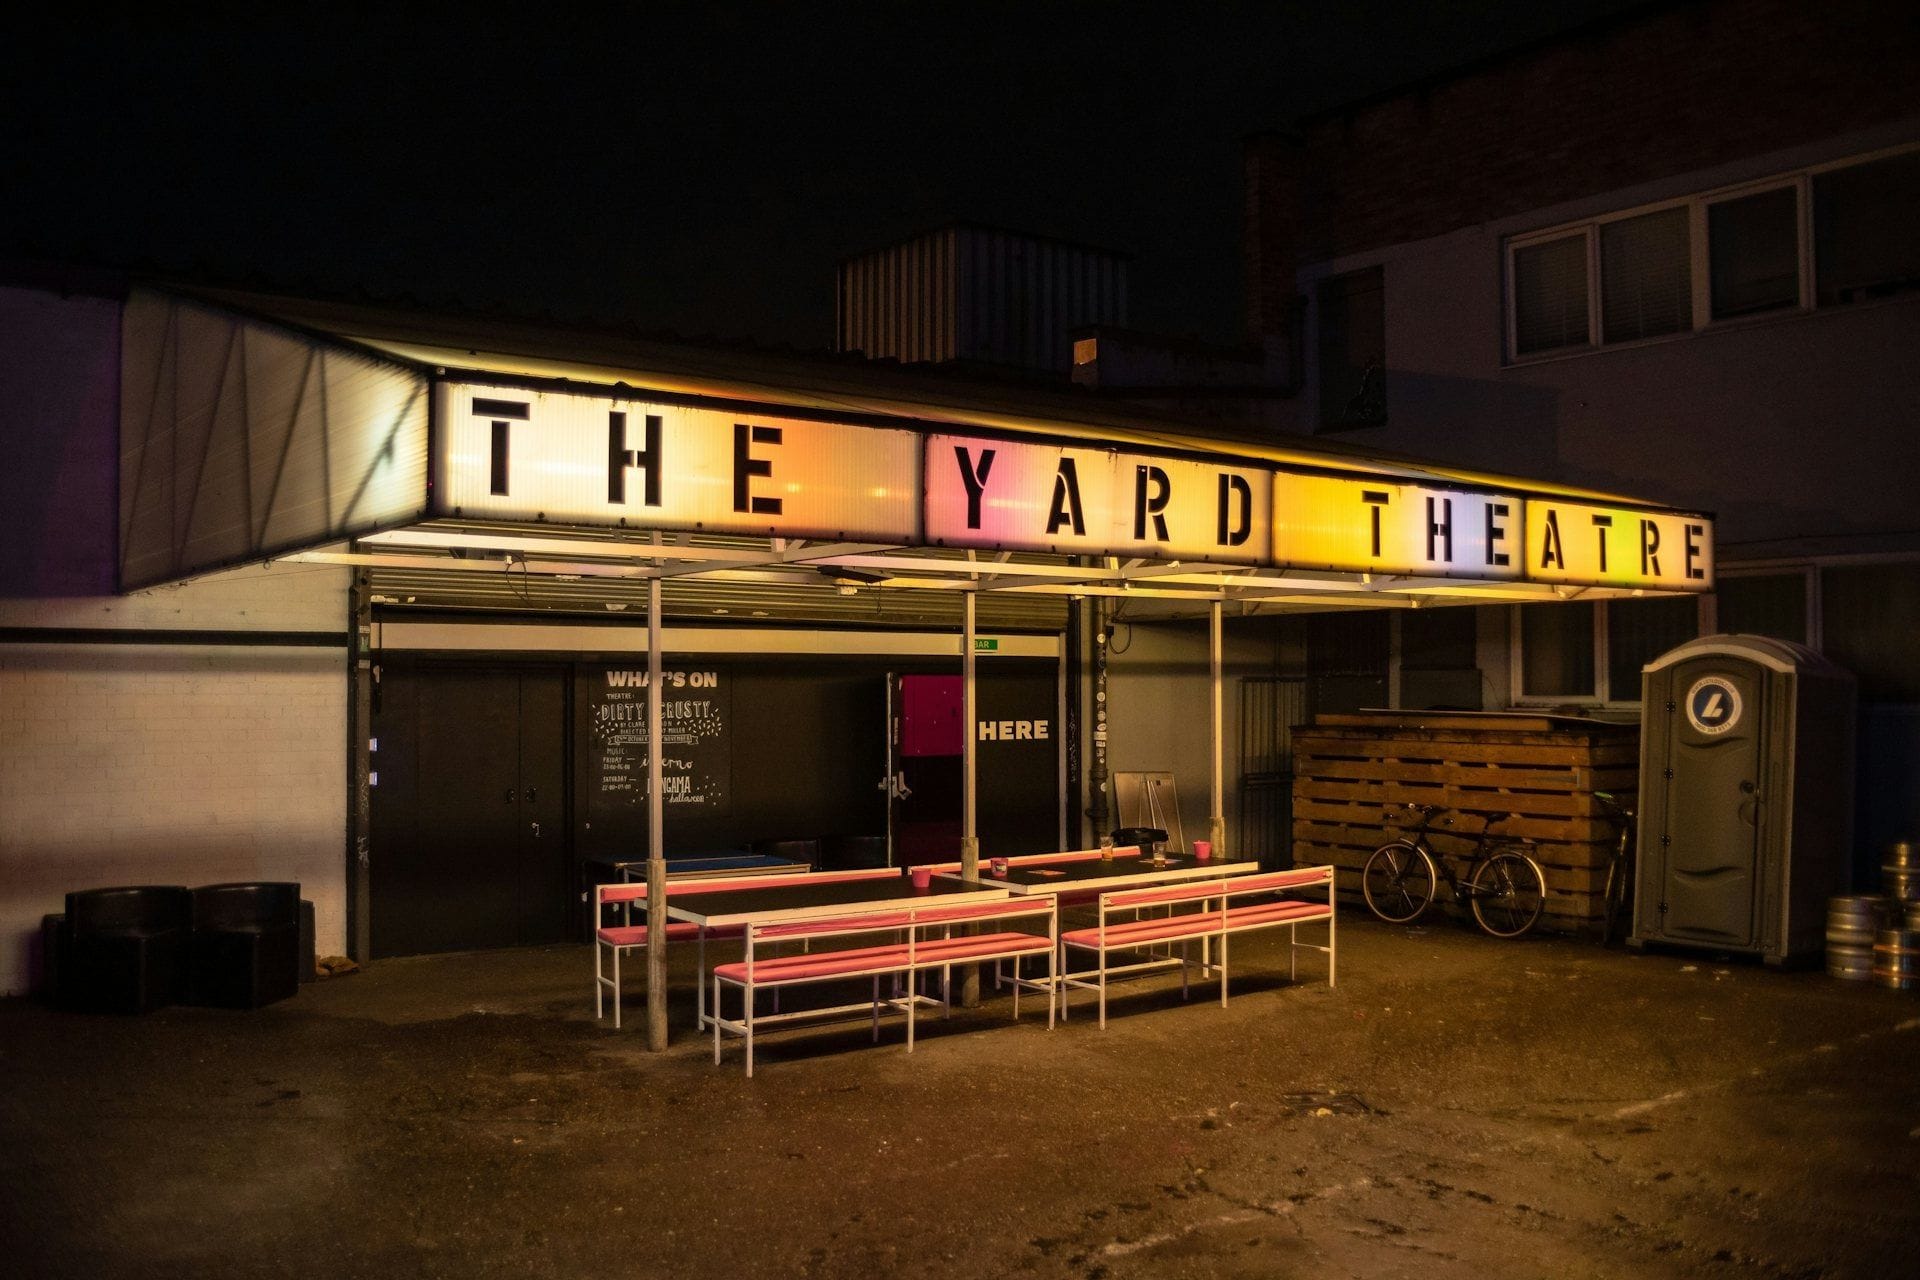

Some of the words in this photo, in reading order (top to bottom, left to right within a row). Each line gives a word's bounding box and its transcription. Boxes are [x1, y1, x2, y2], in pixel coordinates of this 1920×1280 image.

[472, 397, 782, 515] THE
[954, 446, 1251, 546] YARD
[1361, 490, 1704, 579] THEATRE
[690, 671, 718, 688] ON
[601, 703, 645, 721] DIRTY
[978, 719, 1049, 741] HERE
[639, 753, 694, 770] ierno
[647, 776, 691, 794] NGAMA
